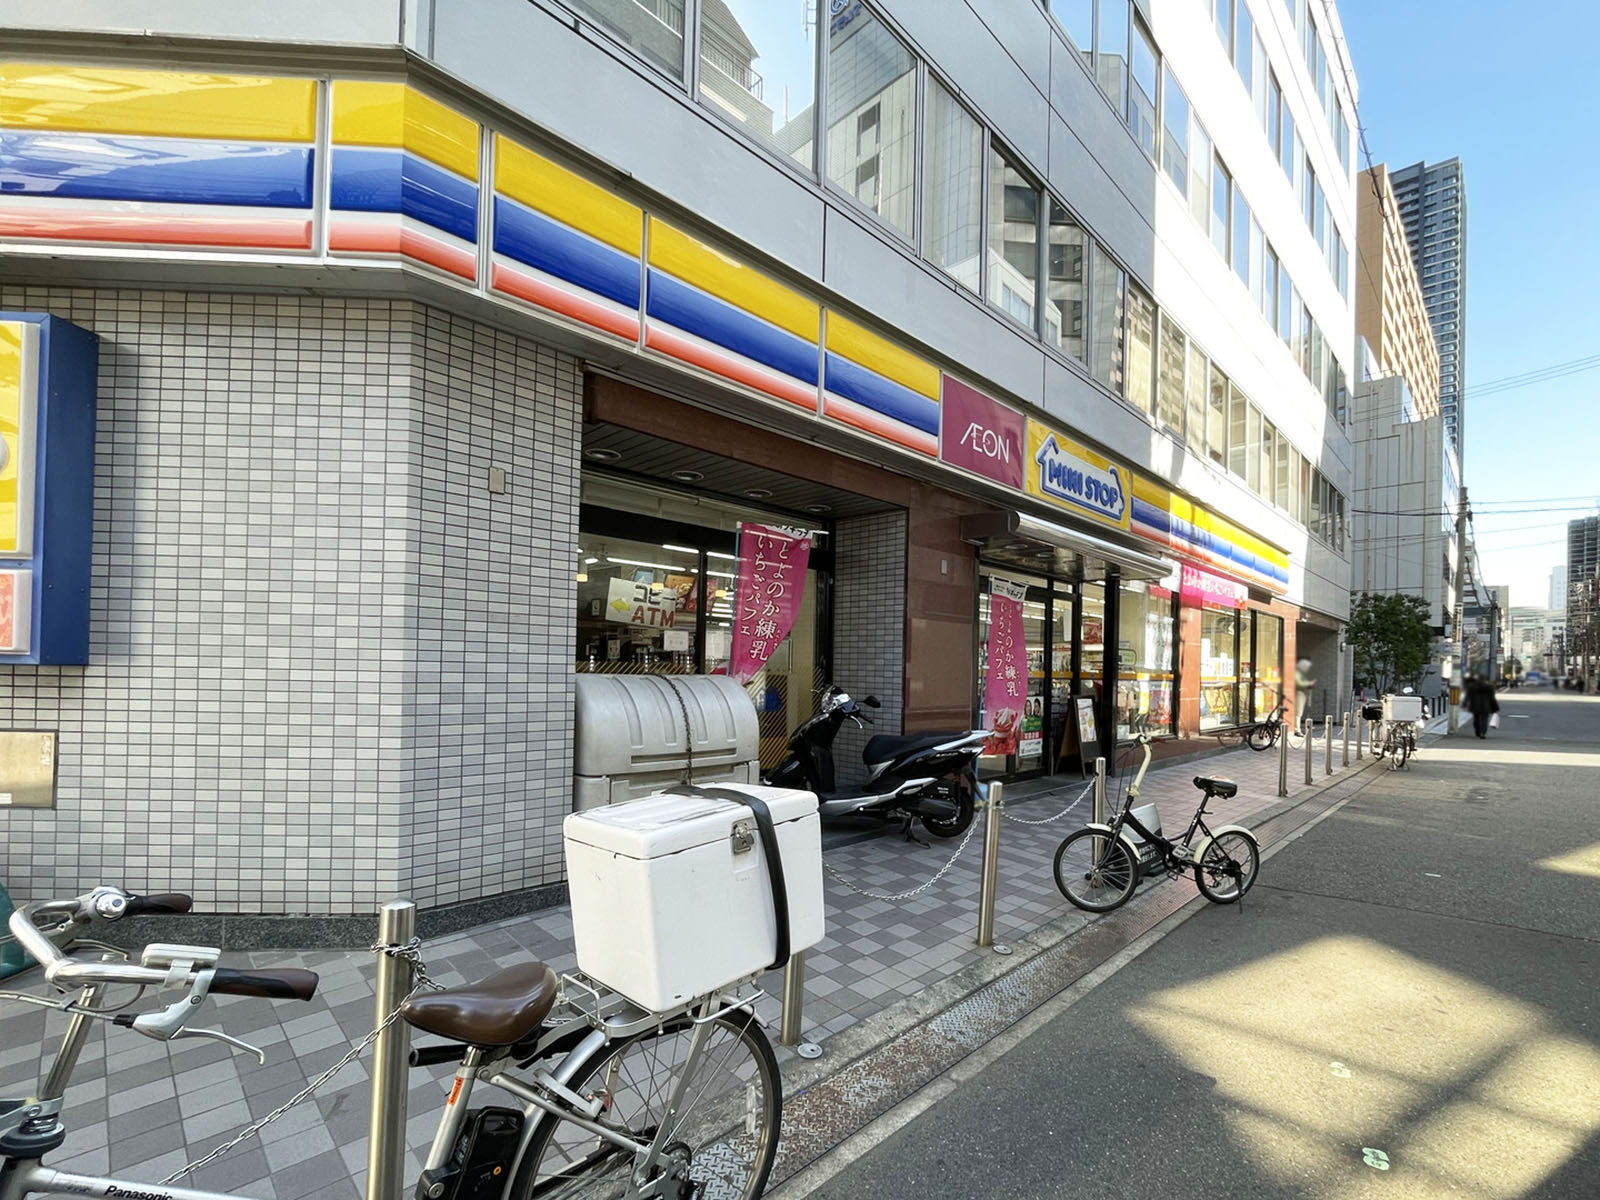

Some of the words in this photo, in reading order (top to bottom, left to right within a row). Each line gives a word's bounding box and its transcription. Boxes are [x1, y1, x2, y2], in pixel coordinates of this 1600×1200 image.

[1048, 457, 1084, 497] MINI
[1084, 475, 1119, 509] STOP
[740, 534, 773, 636] いちごパフェ
[748, 540, 790, 661] とよのか練乳
[631, 605, 676, 628] ATM
[103, 1185, 173, 1200] Panasonic
